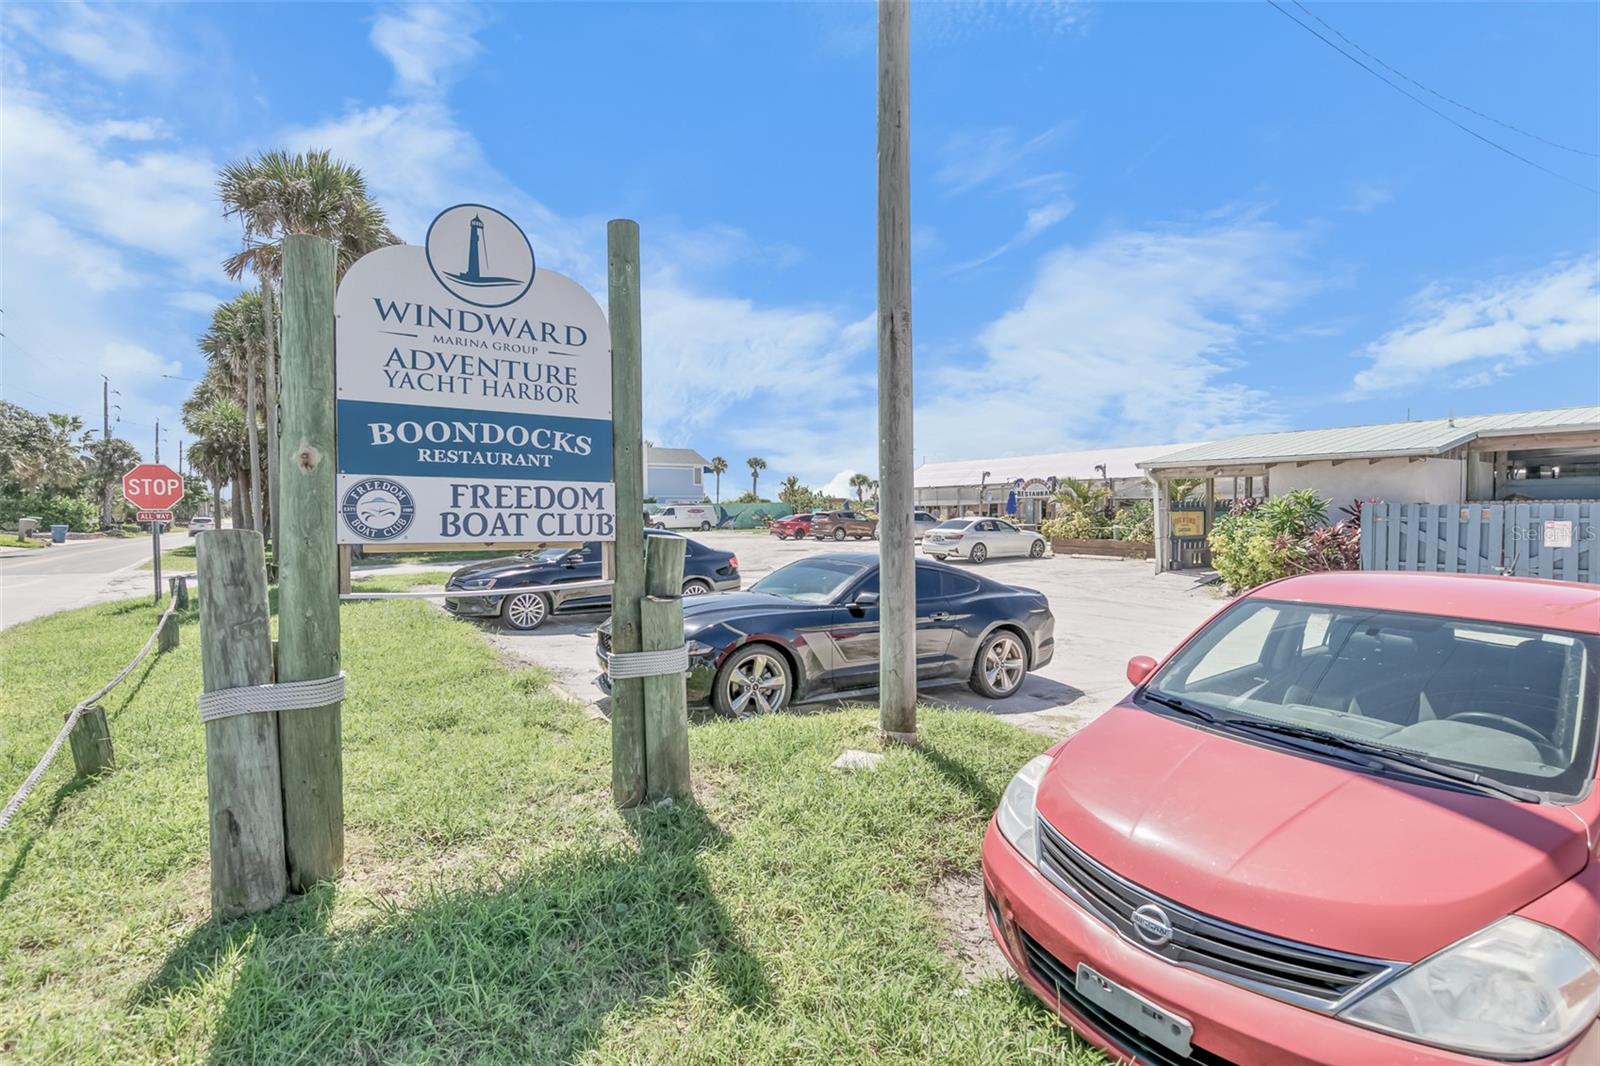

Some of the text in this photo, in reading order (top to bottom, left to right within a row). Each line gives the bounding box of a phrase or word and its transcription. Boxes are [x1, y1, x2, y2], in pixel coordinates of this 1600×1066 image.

[372, 297, 588, 347] WINDWARD
[433, 335, 539, 355] MARINA GROUP
[384, 347, 577, 386] ADVENTURE
[384, 369, 580, 404] YACHT HARBOR
[368, 420, 592, 456] BOONDOCKS
[417, 448, 552, 468] RESTAURANT
[128, 478, 179, 496] STOP
[351, 481, 406, 500] FREEDOM
[450, 484, 605, 511] FREEDOM
[351, 518, 407, 537] BOAT CLUB
[440, 512, 614, 537] BOAT CLUB
